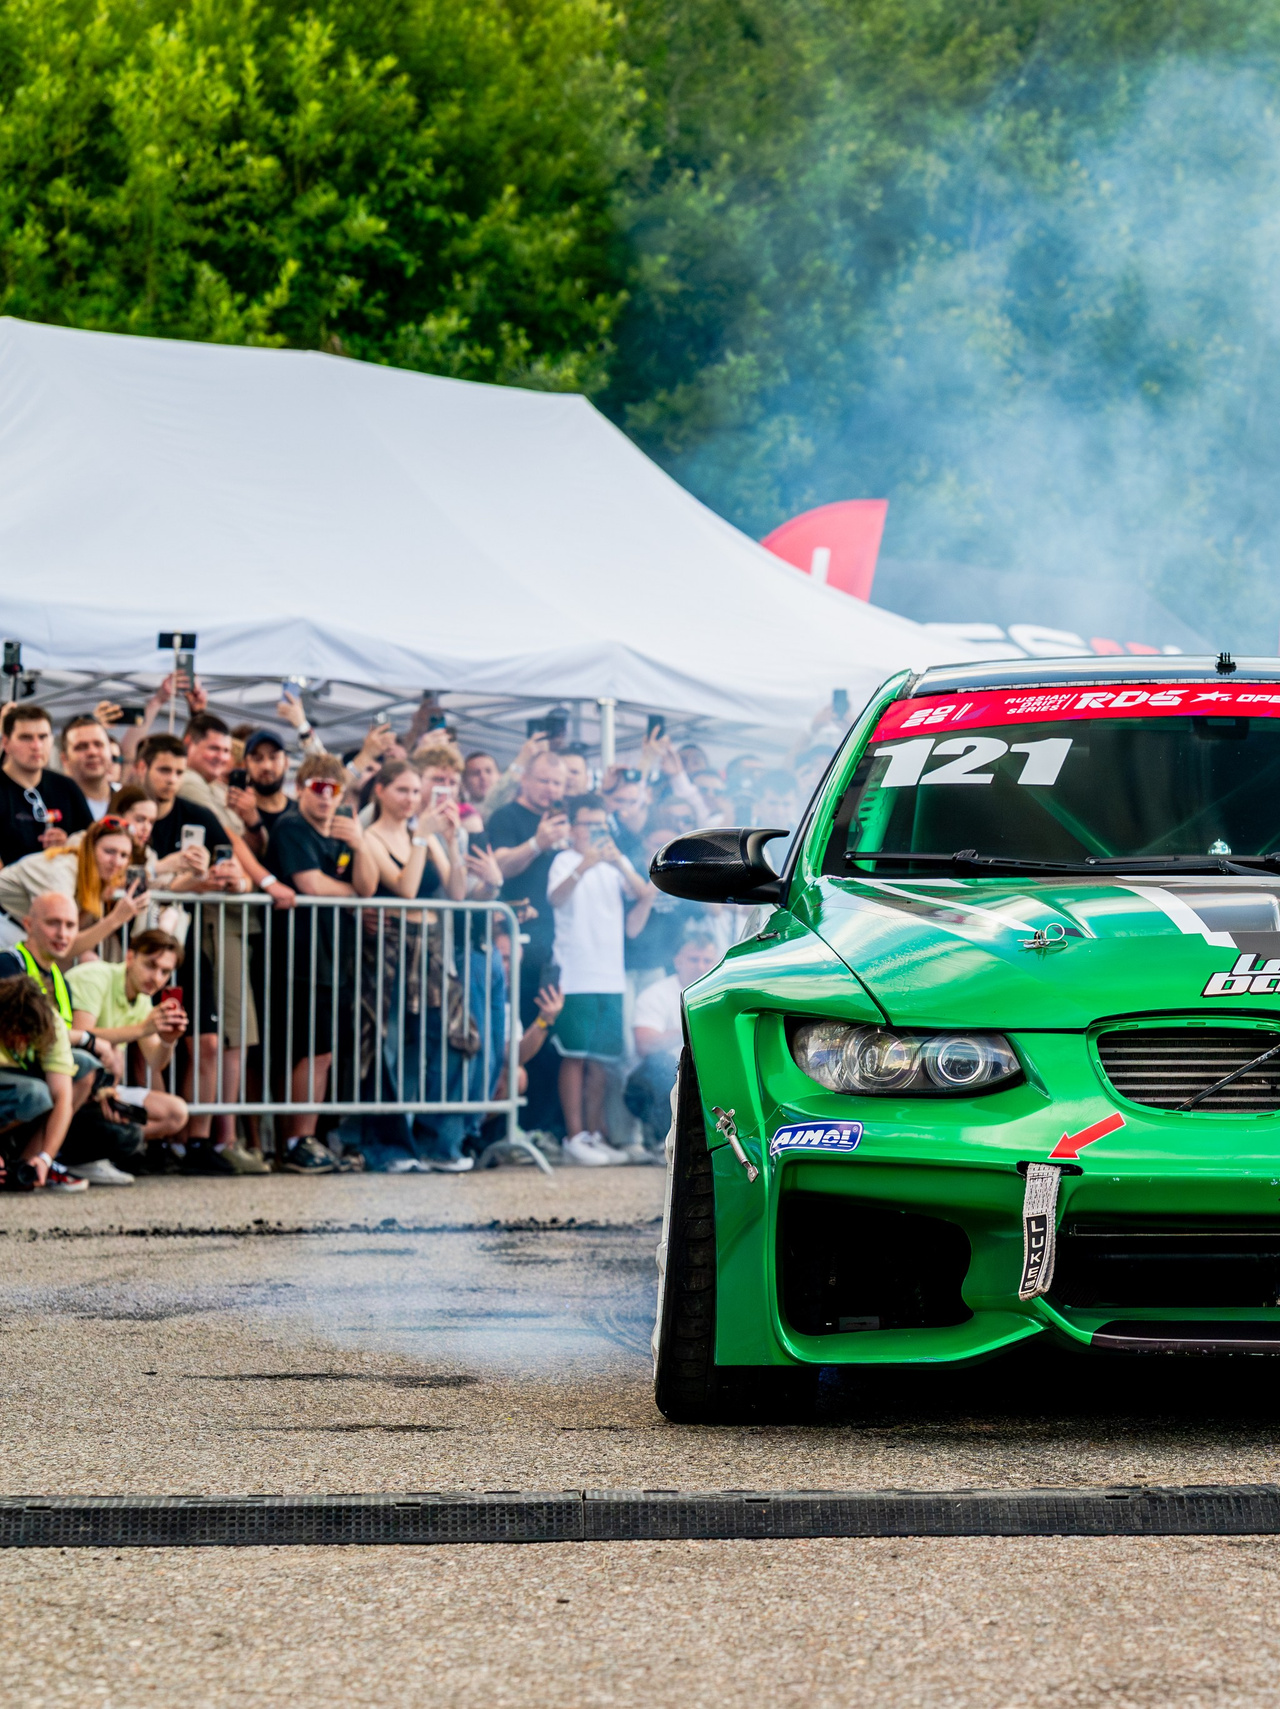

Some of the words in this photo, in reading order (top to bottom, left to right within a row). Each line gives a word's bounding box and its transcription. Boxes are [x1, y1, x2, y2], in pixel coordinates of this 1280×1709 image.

[1004, 693, 1072, 704] RUSSIAN
[1020, 699, 1066, 708] DRIFT
[1073, 690, 1190, 709] RDS
[1006, 705, 1060, 715] SERIES
[873, 736, 1074, 788] 121
[772, 1129, 854, 1149] AIMOL
[1027, 1220, 1045, 1279] LUKE
